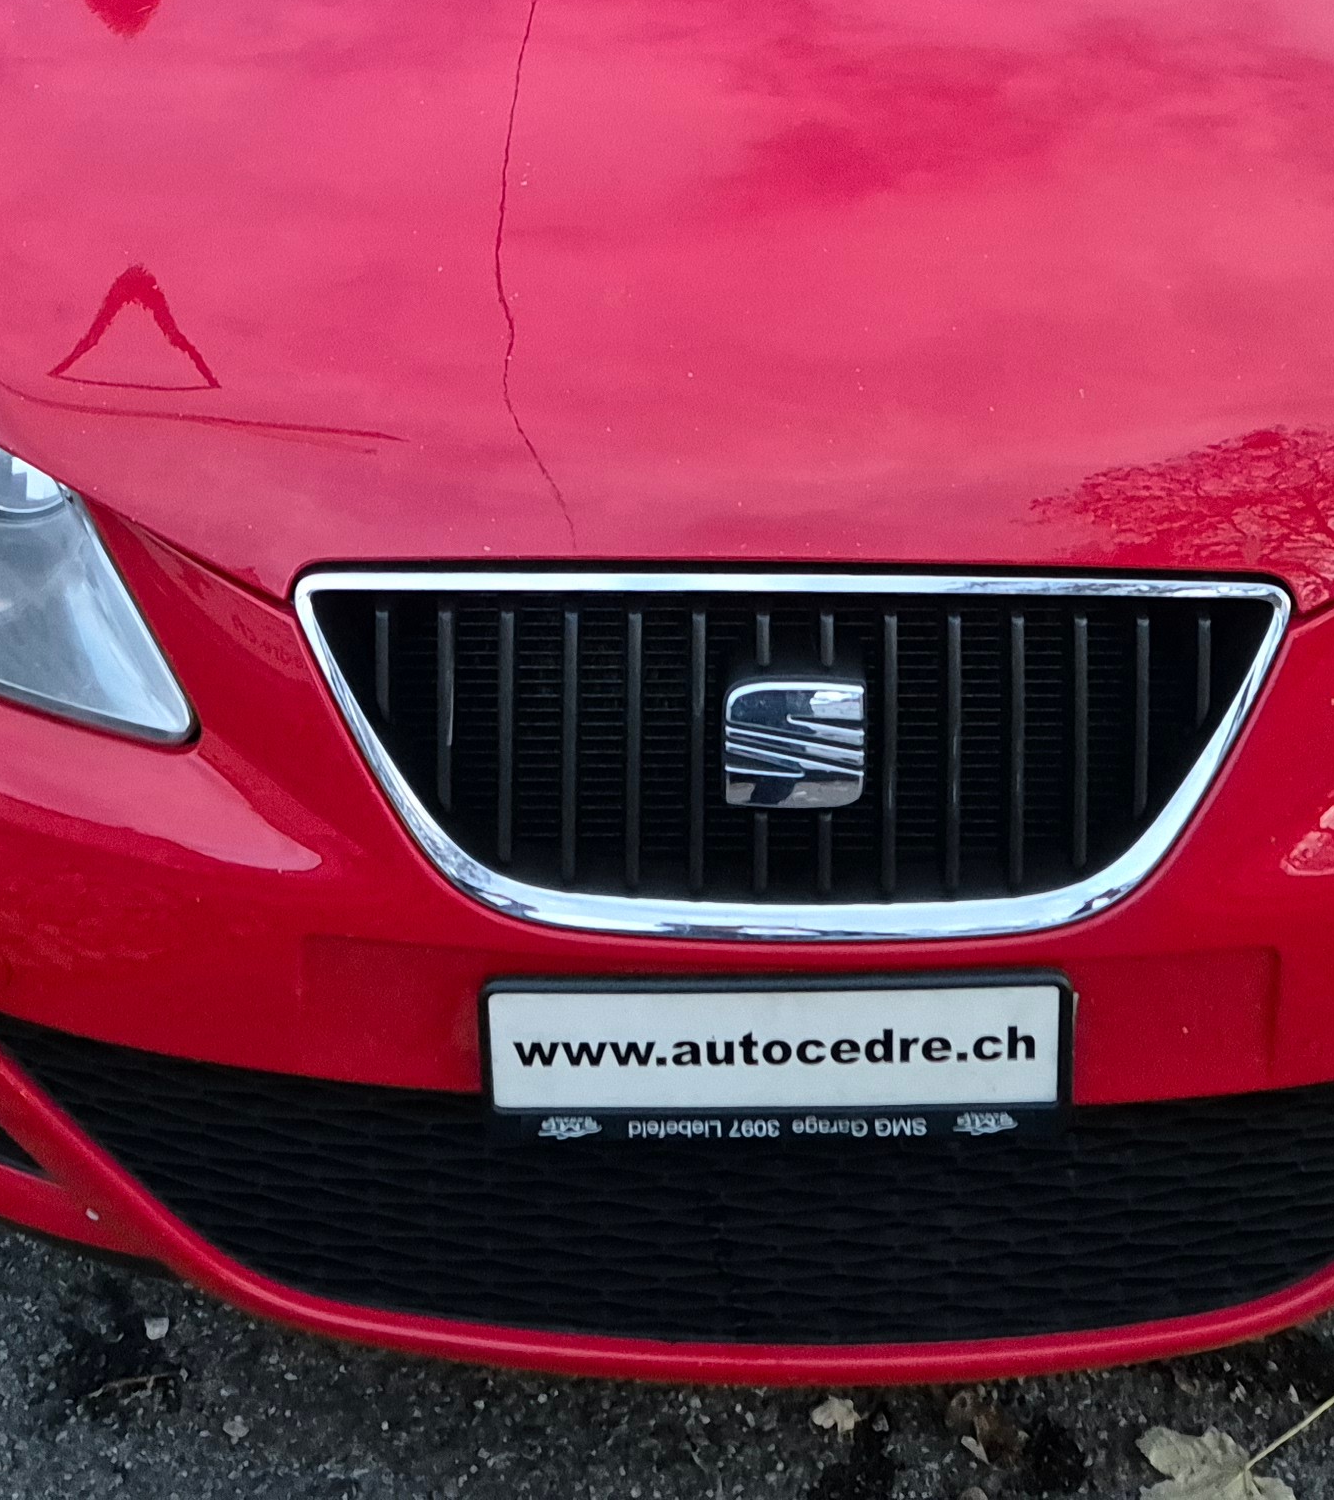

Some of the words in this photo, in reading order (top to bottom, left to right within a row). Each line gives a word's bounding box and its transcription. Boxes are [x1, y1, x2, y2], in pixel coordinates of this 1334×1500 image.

[512, 1025, 1036, 1068] www.autocedre.ch
[628, 1118, 723, 1139] Liebefeld
[728, 1117, 782, 1138] 3097
[792, 1115, 869, 1138] Garage
[874, 1117, 928, 1138] SMG
